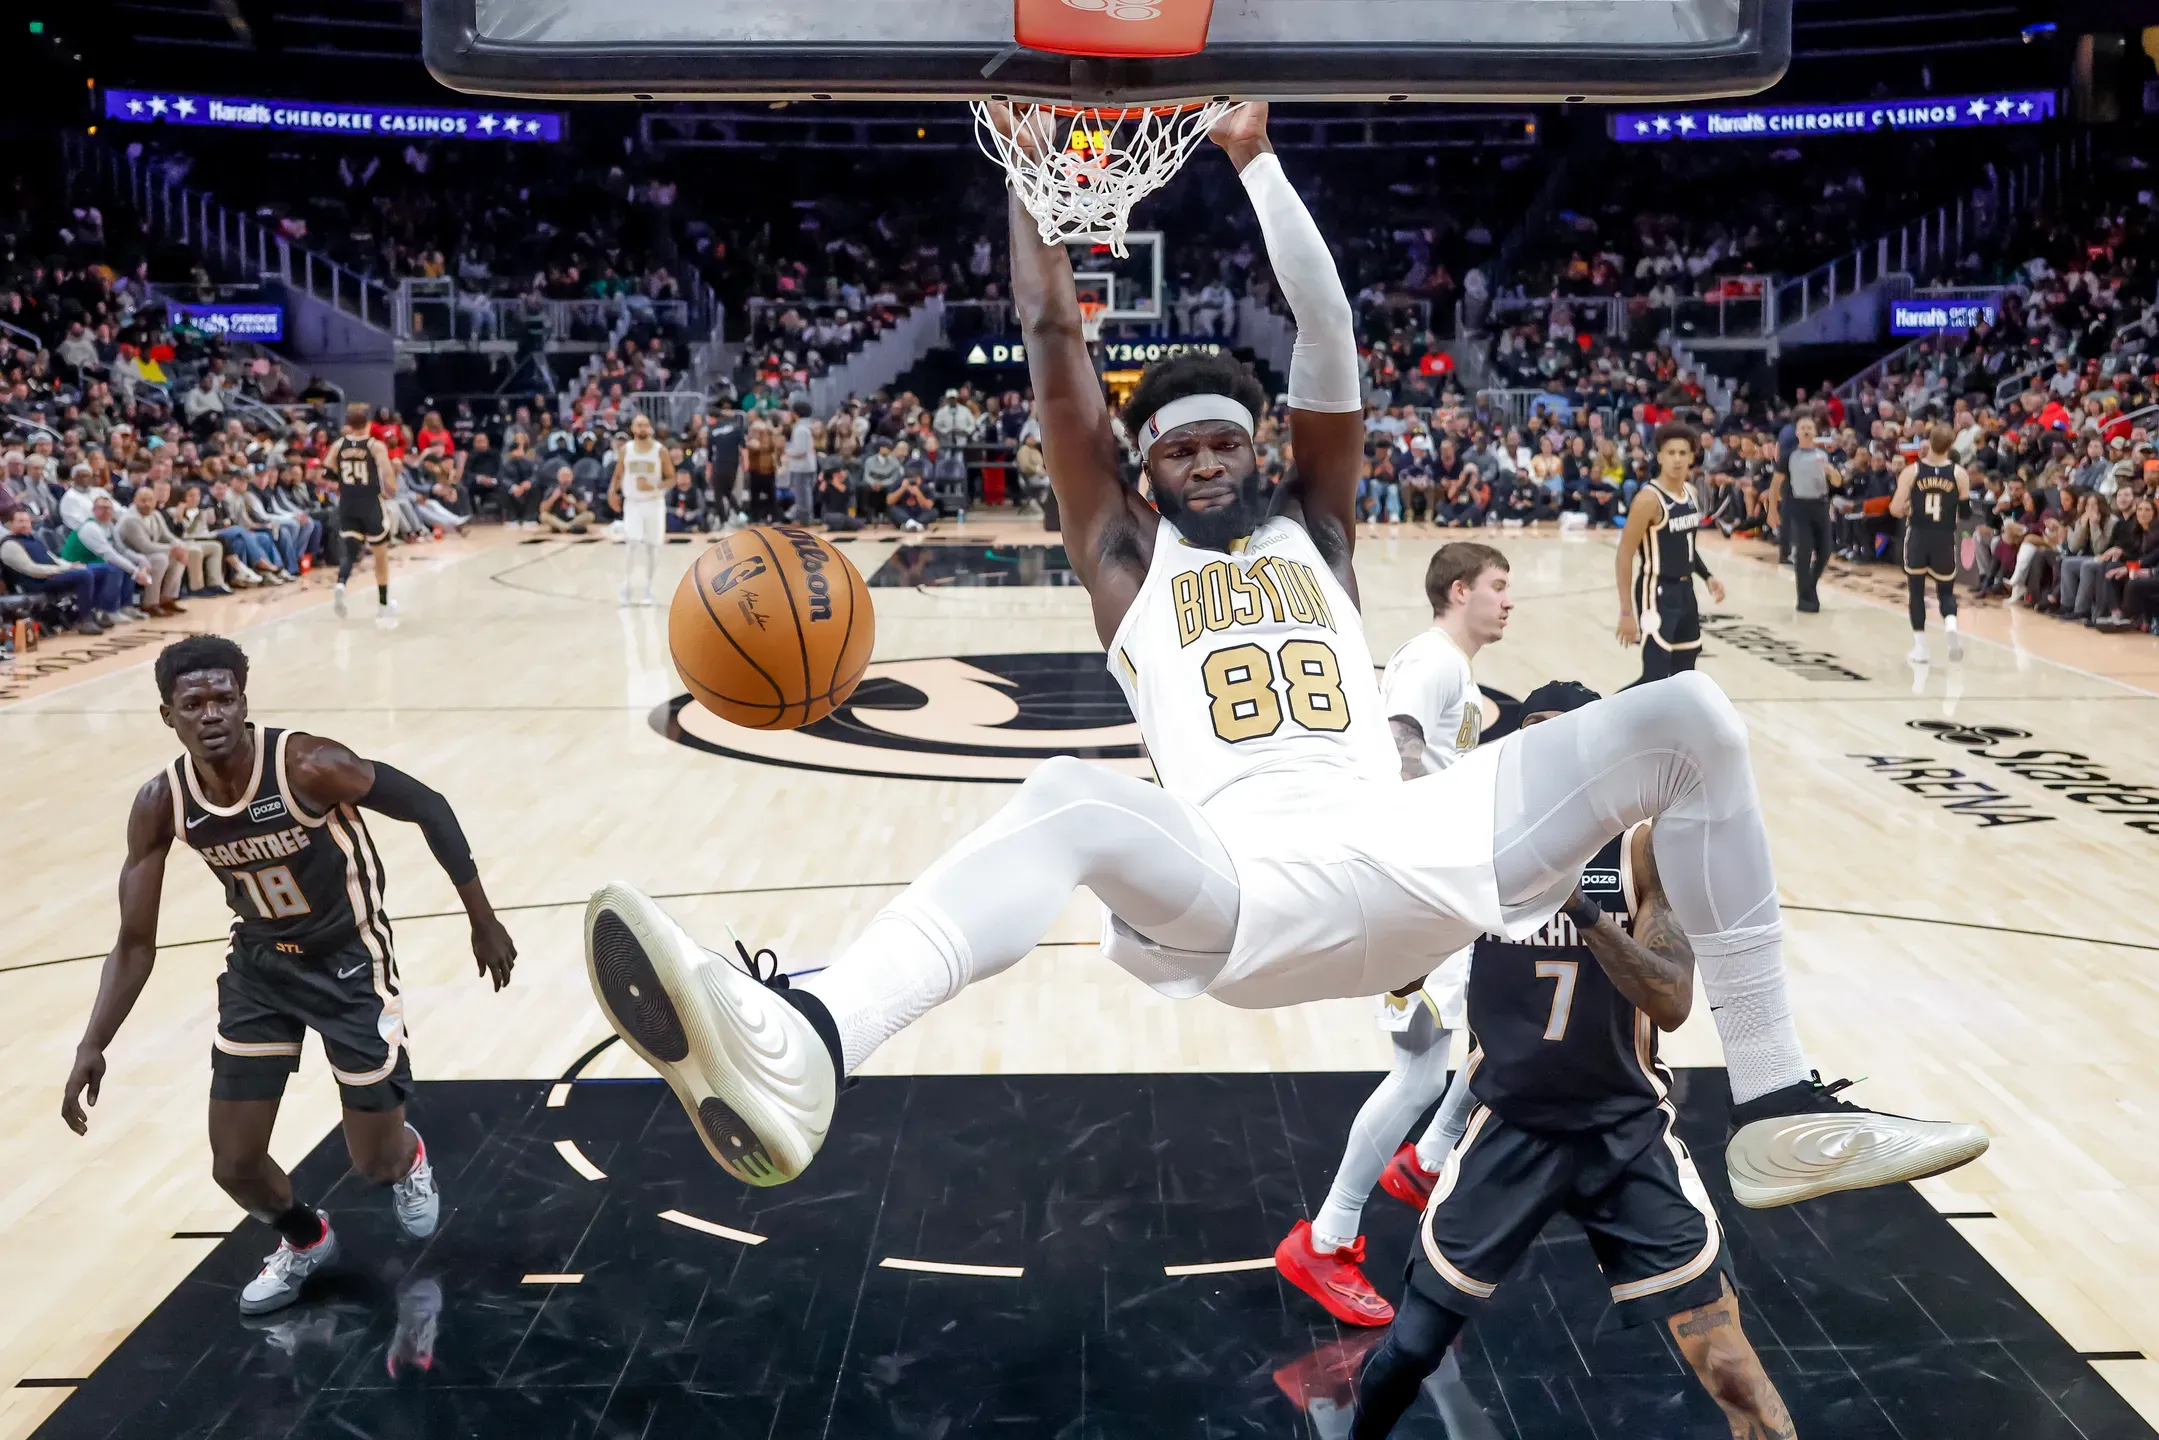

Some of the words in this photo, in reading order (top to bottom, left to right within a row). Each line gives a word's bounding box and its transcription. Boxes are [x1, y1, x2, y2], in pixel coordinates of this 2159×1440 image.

[273, 108, 373, 130] CHEROKEE
[379, 114, 467, 134] CASINOS
[1769, 113, 1865, 131] CHEROKEE
[340, 460, 369, 485] 24
[1925, 493, 1942, 522] 4
[1251, 533, 1290, 556] Amica
[1686, 531, 1694, 563] 1
[1171, 556, 1338, 649] BOSTON
[1201, 639, 1351, 744] 88
[1846, 753, 2057, 828] ARENA
[253, 801, 282, 817] paze
[232, 865, 311, 919] 18
[1581, 874, 1617, 886] paze
[1535, 960, 1579, 1041] 7
